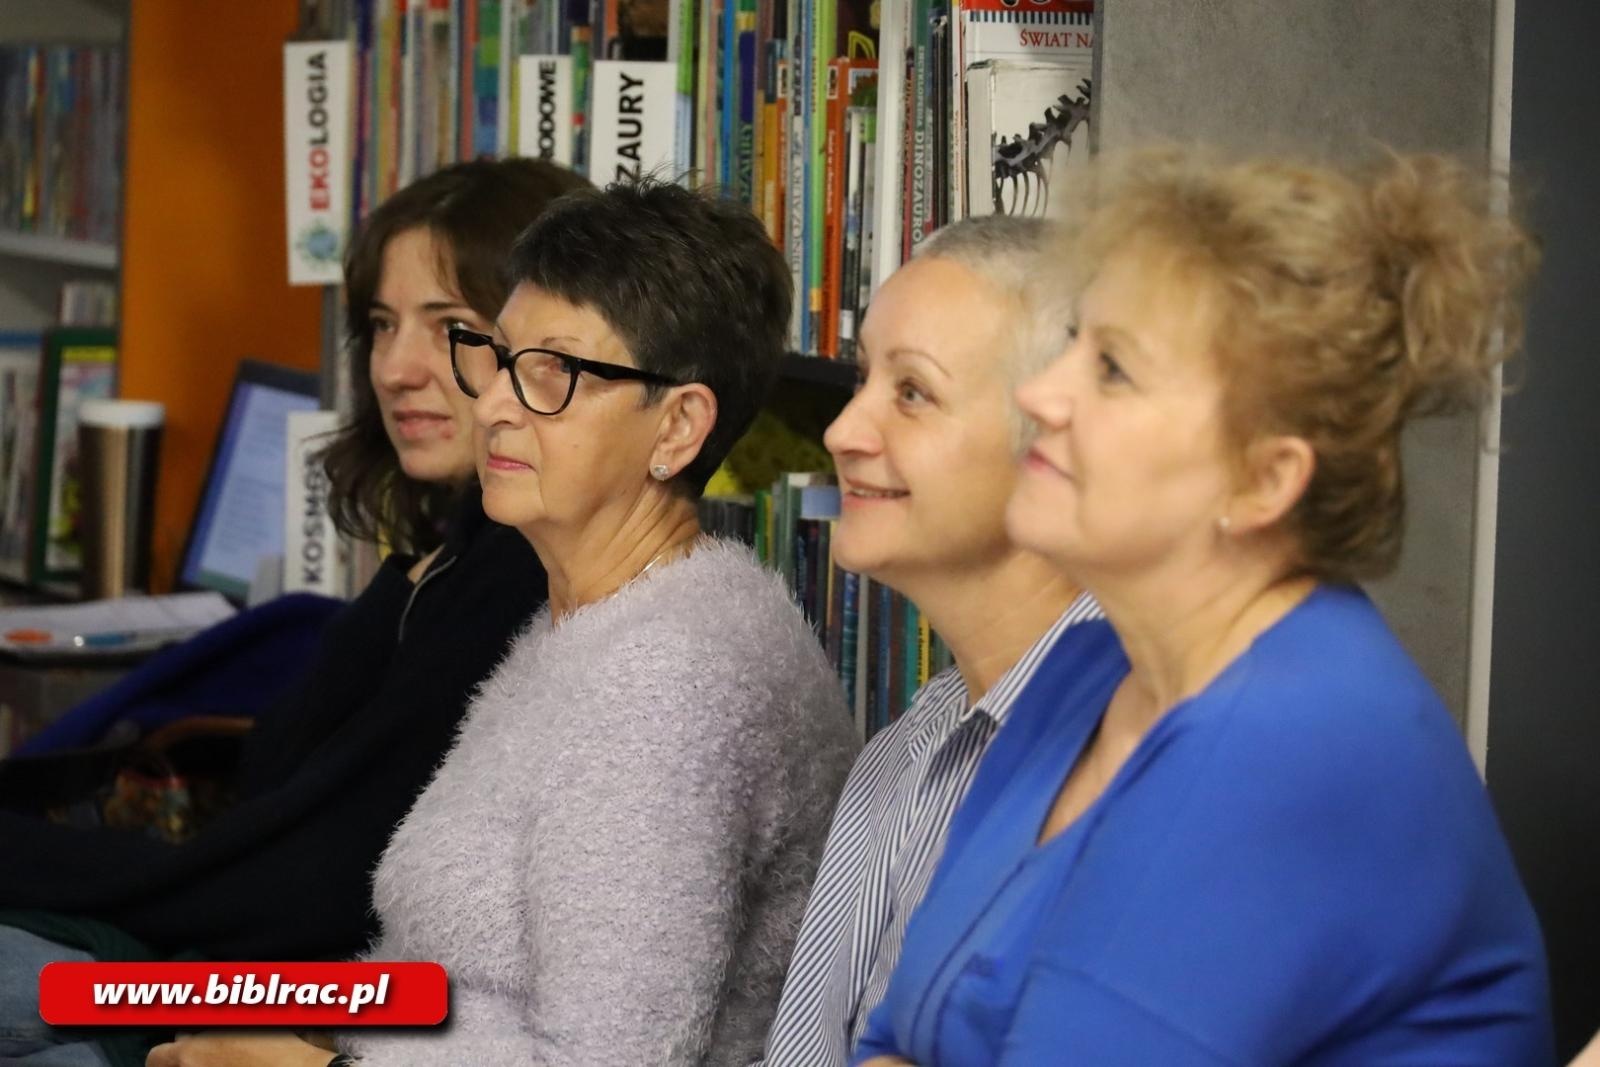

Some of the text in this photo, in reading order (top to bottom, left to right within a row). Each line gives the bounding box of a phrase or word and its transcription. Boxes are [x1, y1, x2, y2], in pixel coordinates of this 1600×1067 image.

[917, 45, 925, 127] ENCYKLOPEDIA
[1020, 28, 1071, 48] ŚWIAT
[307, 52, 330, 211] EKOLOGIA
[792, 164, 803, 274] DINOZAURY
